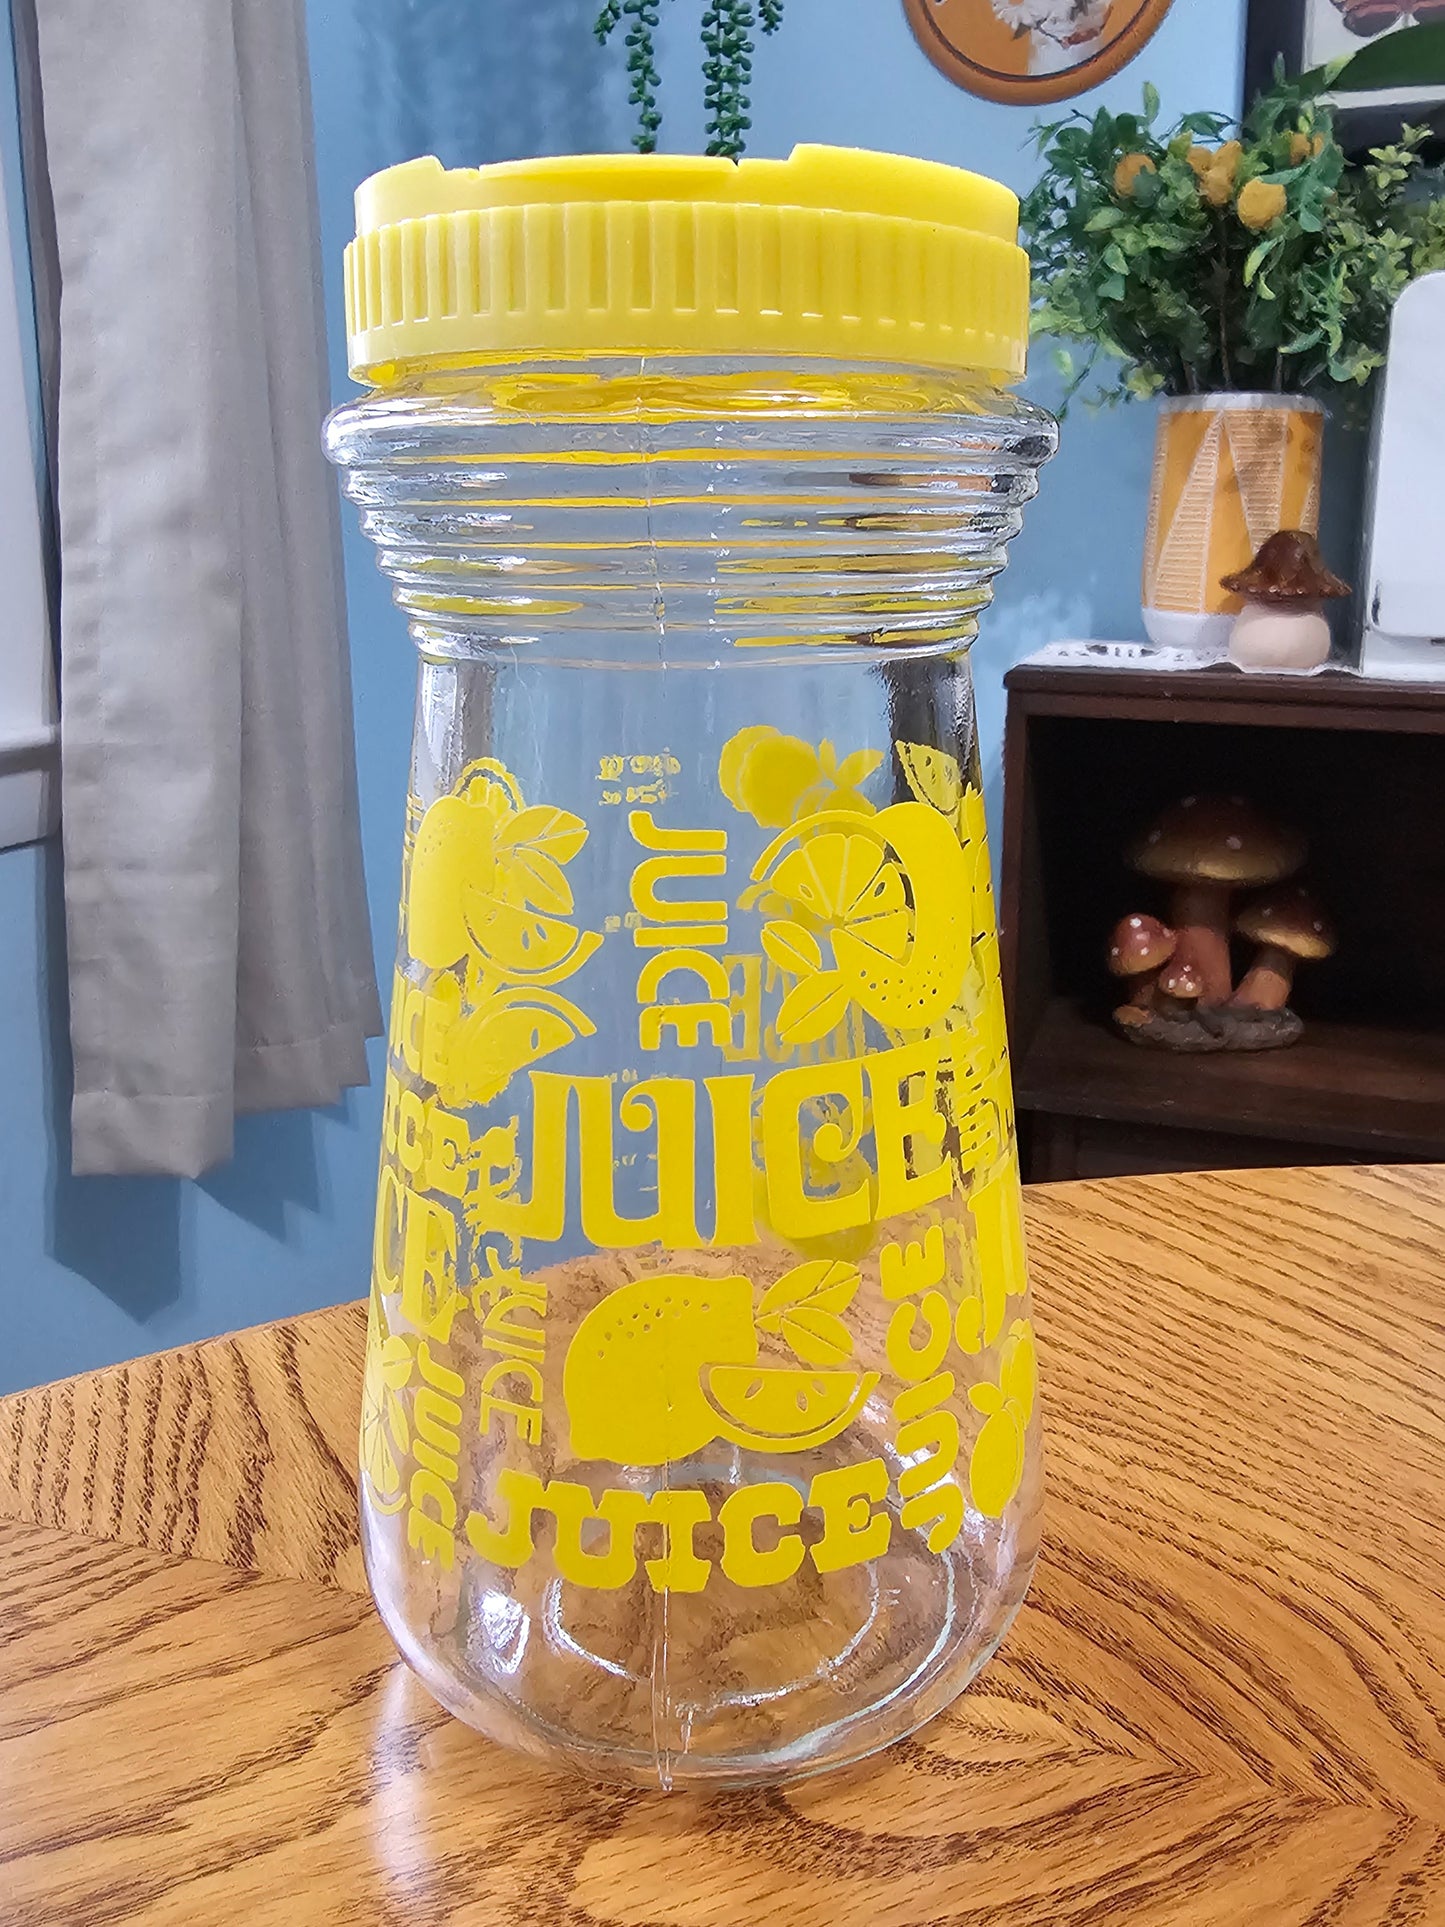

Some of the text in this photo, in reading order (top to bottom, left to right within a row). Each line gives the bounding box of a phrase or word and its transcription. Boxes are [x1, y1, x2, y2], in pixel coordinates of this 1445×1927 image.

[629, 810, 731, 1050] JUICE
[474, 1030, 954, 1253] JUICE
[407, 1340, 466, 1572] JUICE
[479, 1246, 548, 1446] JUICE
[879, 1225, 964, 1554] JUICE
[465, 1457, 894, 1593] JUICE
